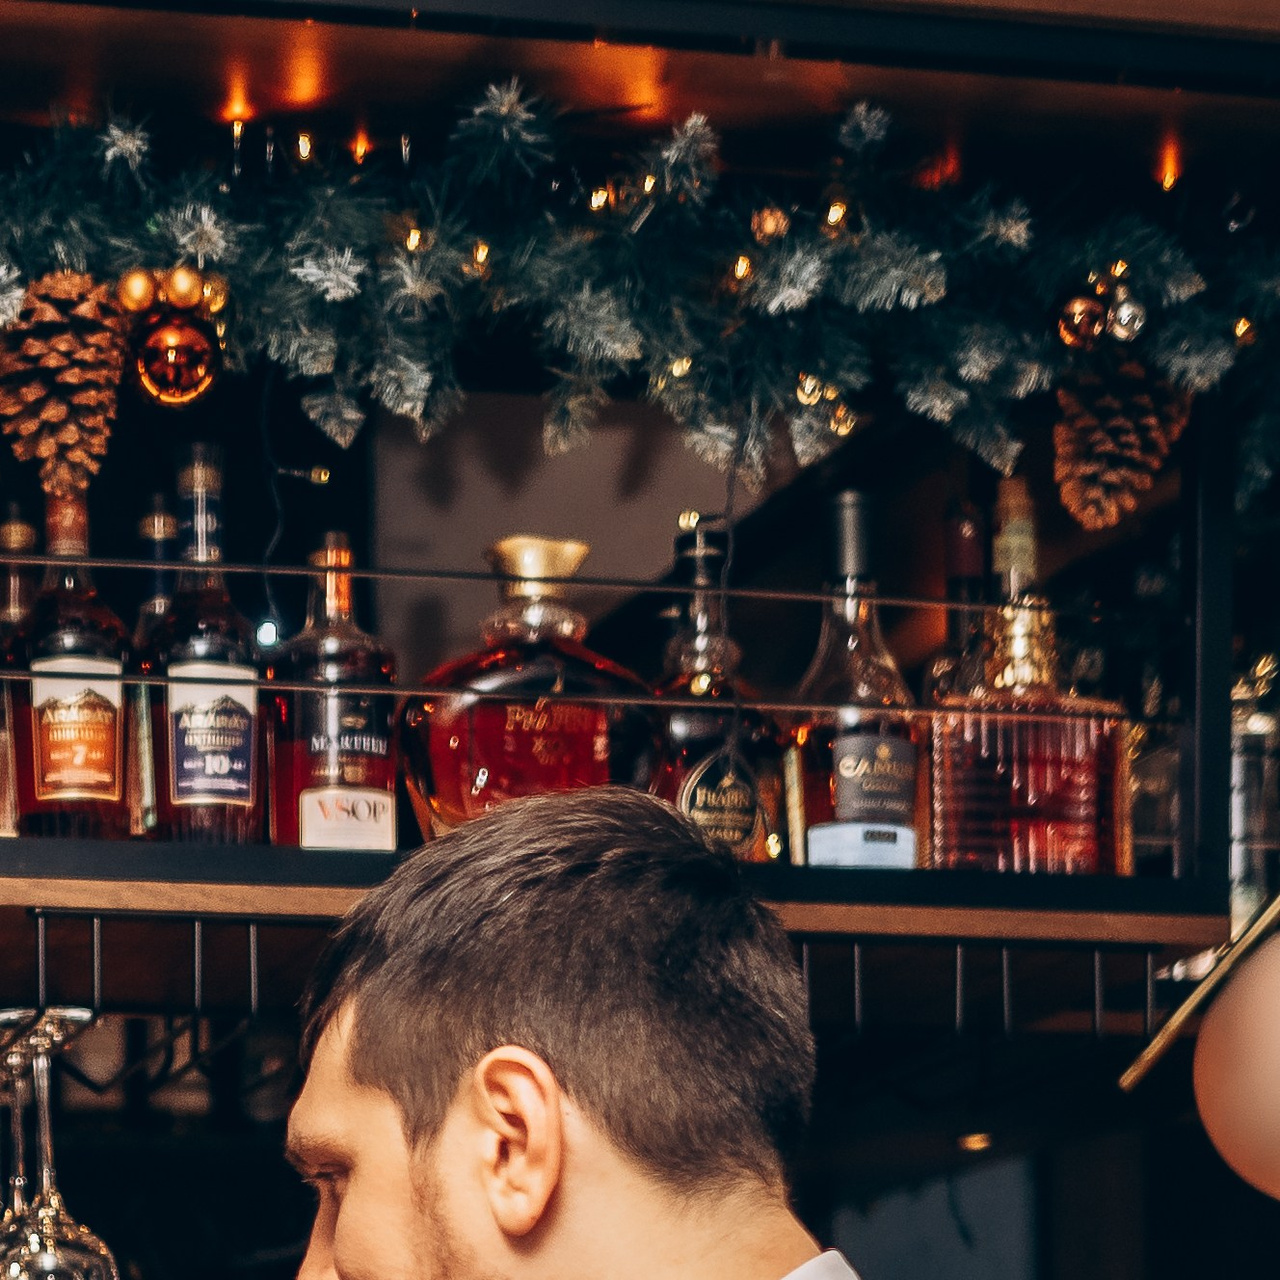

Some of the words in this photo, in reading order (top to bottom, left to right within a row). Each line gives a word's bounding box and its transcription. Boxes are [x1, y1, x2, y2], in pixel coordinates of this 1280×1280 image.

[71, 744, 88, 766] 7
[204, 753, 231, 775] 10
[317, 798, 386, 823] VSOP
